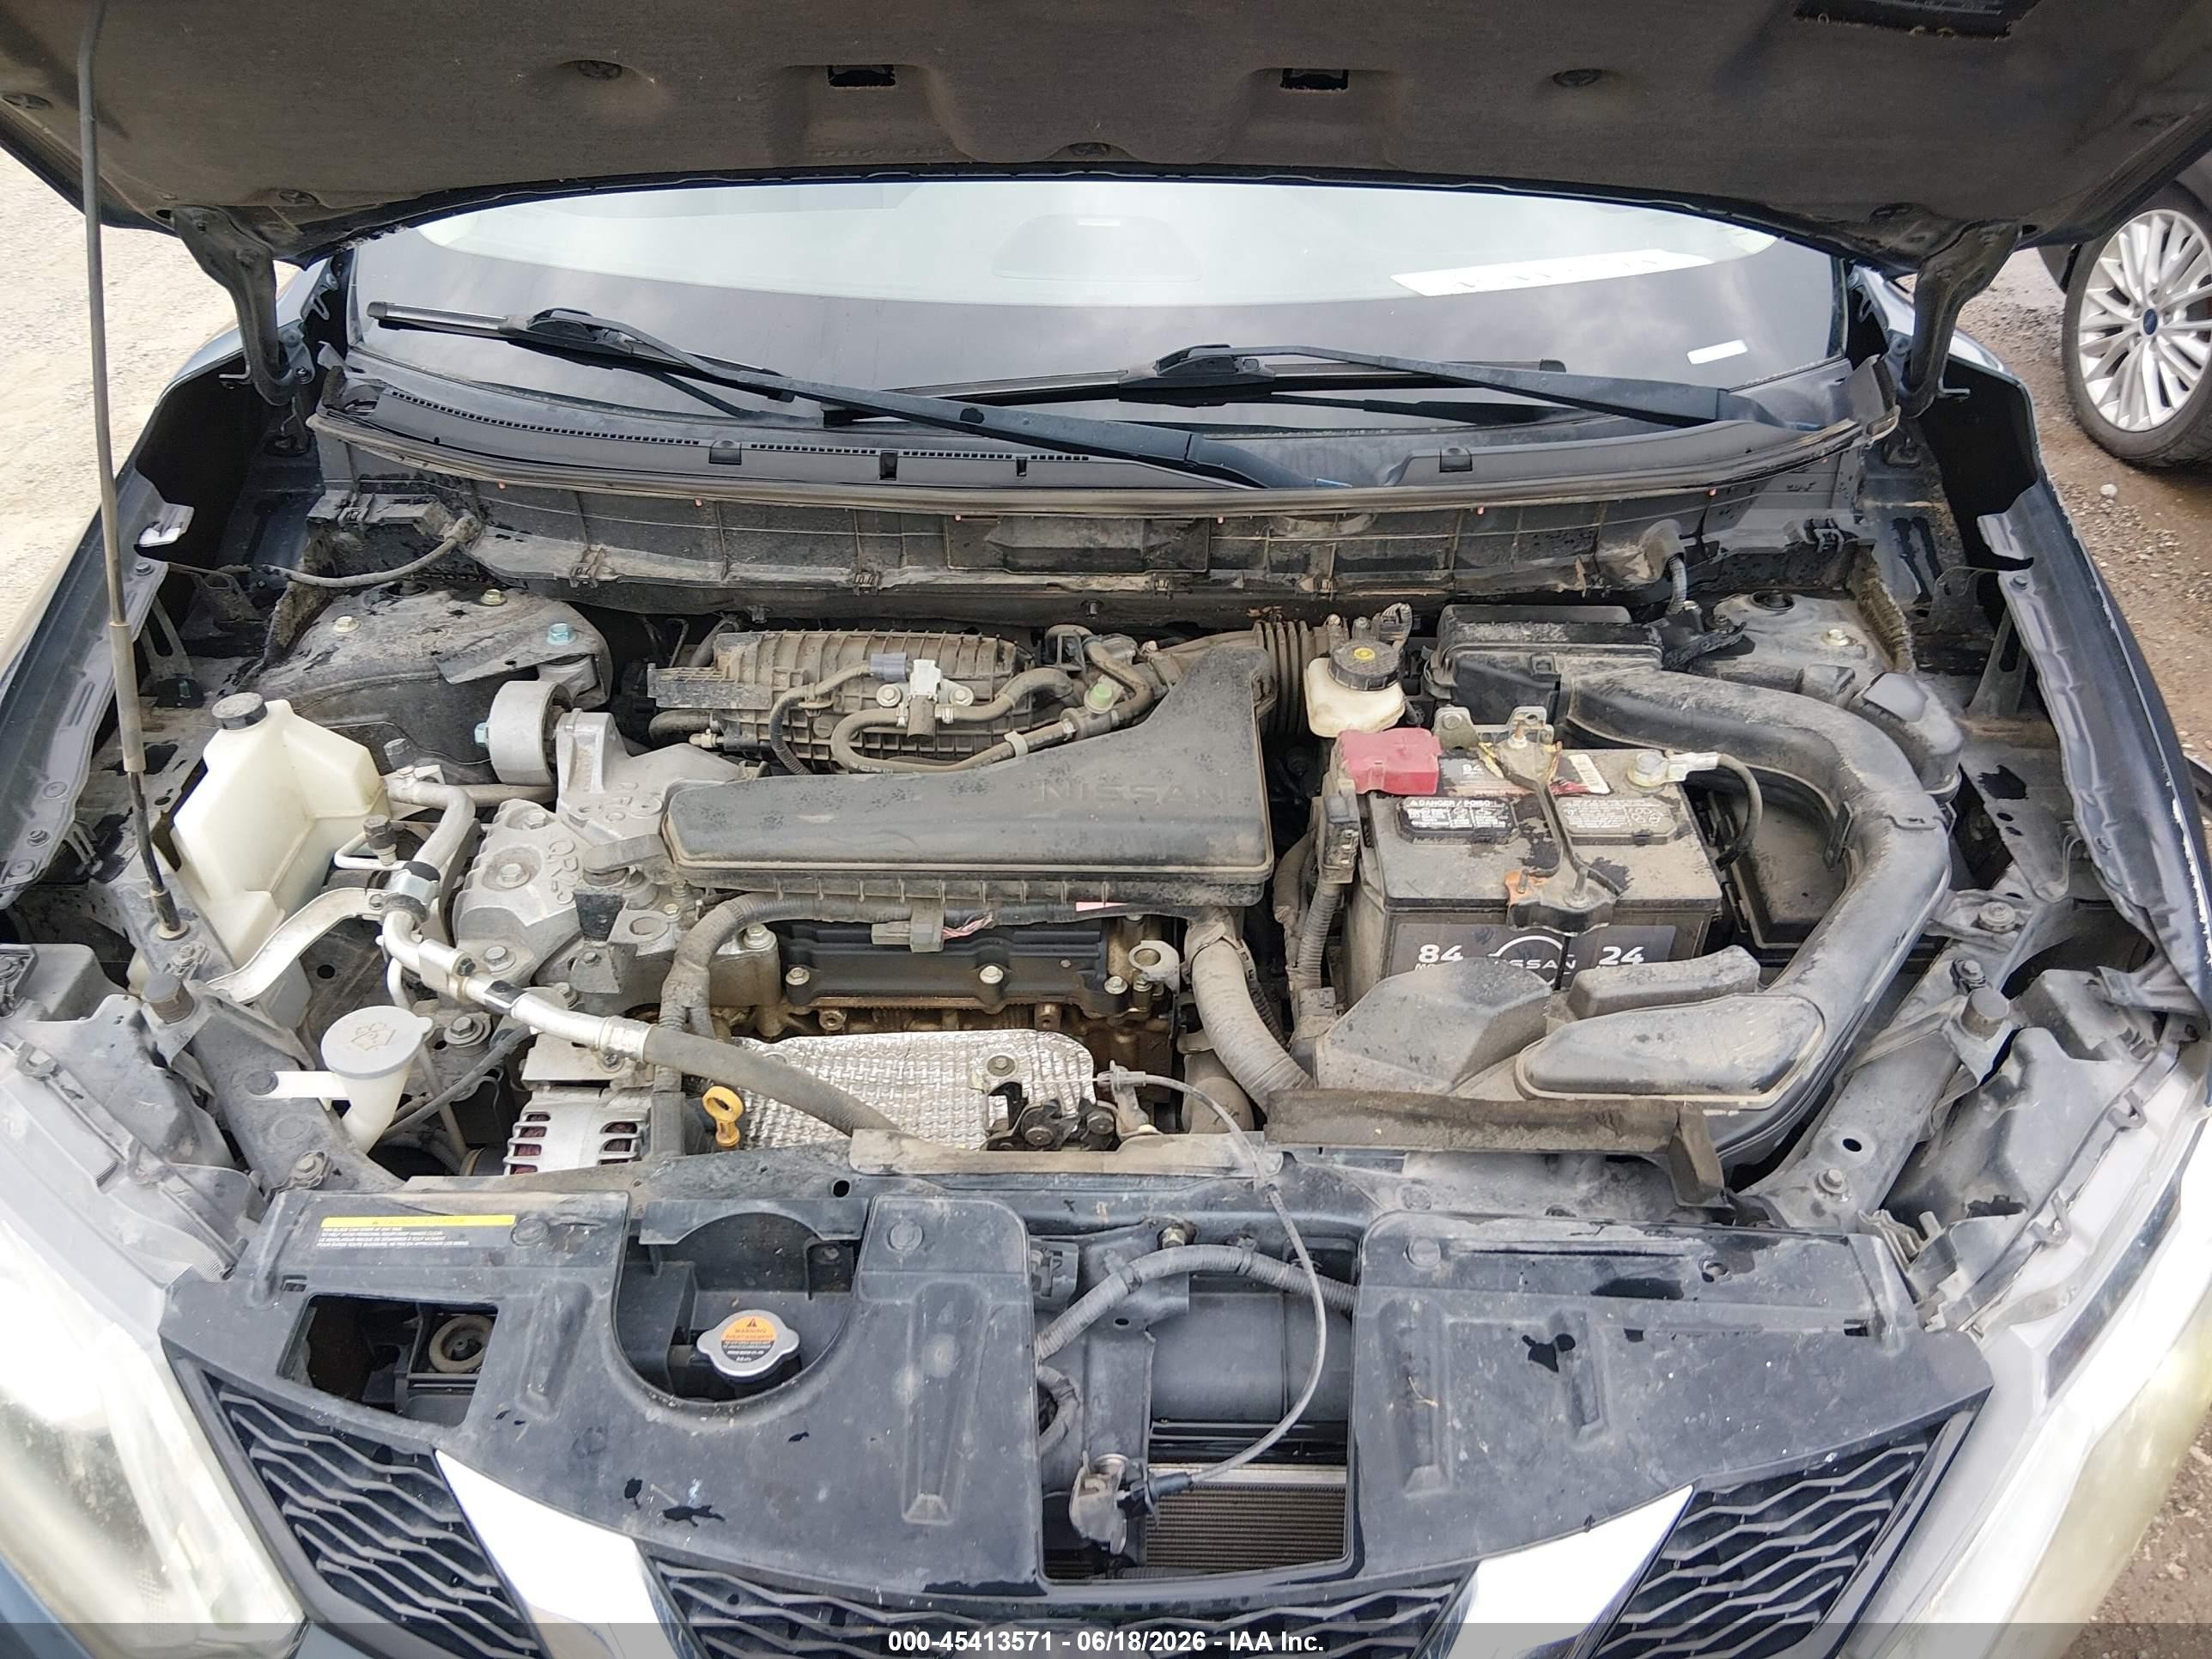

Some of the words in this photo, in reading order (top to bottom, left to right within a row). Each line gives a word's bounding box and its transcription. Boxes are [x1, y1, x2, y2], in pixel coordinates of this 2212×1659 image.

[1036, 782, 1232, 805] NISSAN
[1418, 944, 1464, 963] 84
[1598, 945, 1644, 965] 24
